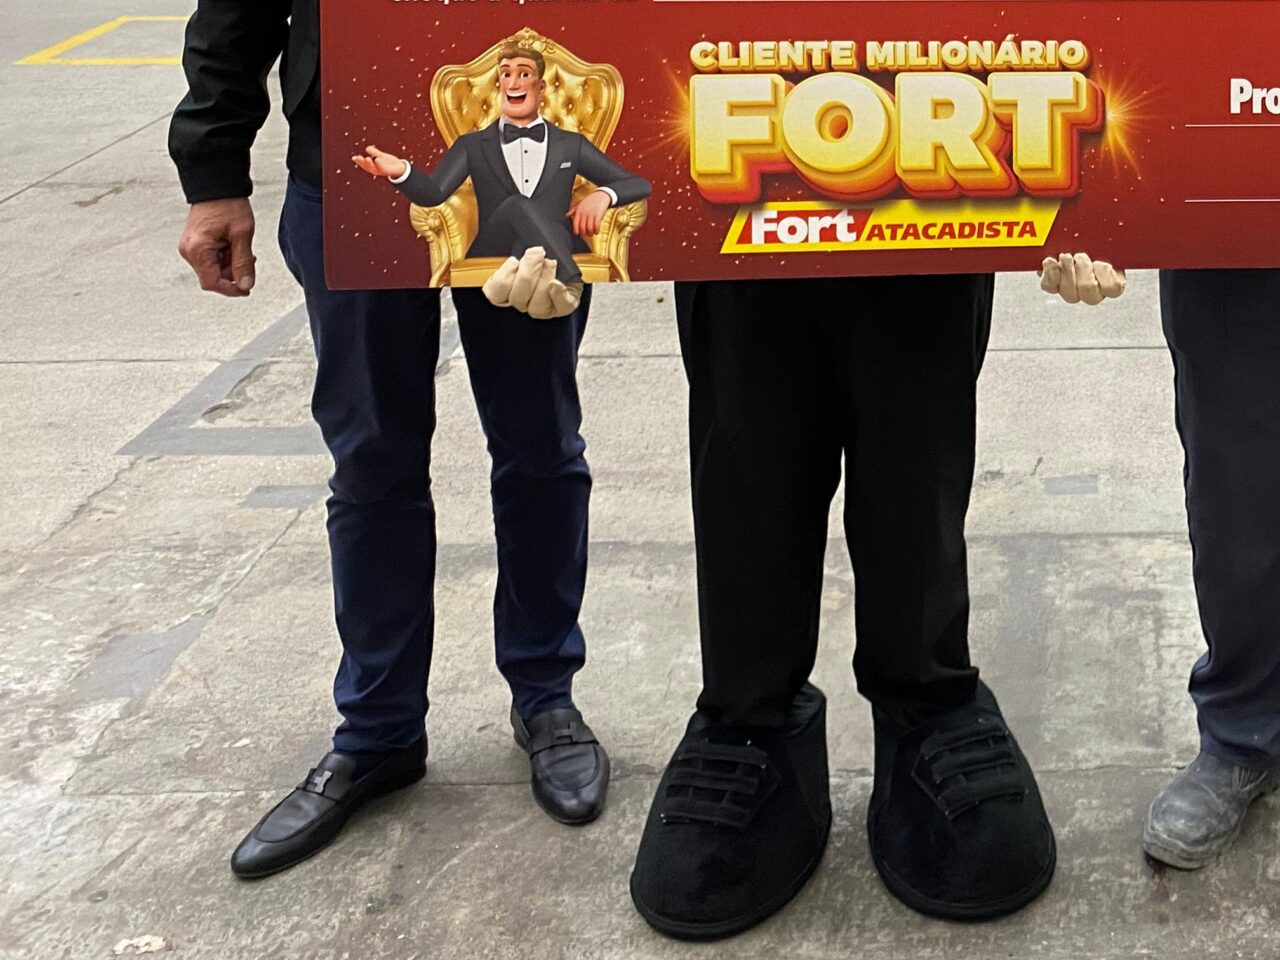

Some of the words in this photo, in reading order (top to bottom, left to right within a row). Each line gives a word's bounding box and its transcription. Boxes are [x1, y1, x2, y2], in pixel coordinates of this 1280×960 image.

[690, 41, 857, 72] CLIENTE
[867, 35, 1091, 72] MILIONÁRIO
[690, 72, 1098, 194] FORT
[751, 208, 858, 245] Fort
[867, 221, 1038, 240] ATACADISTA
